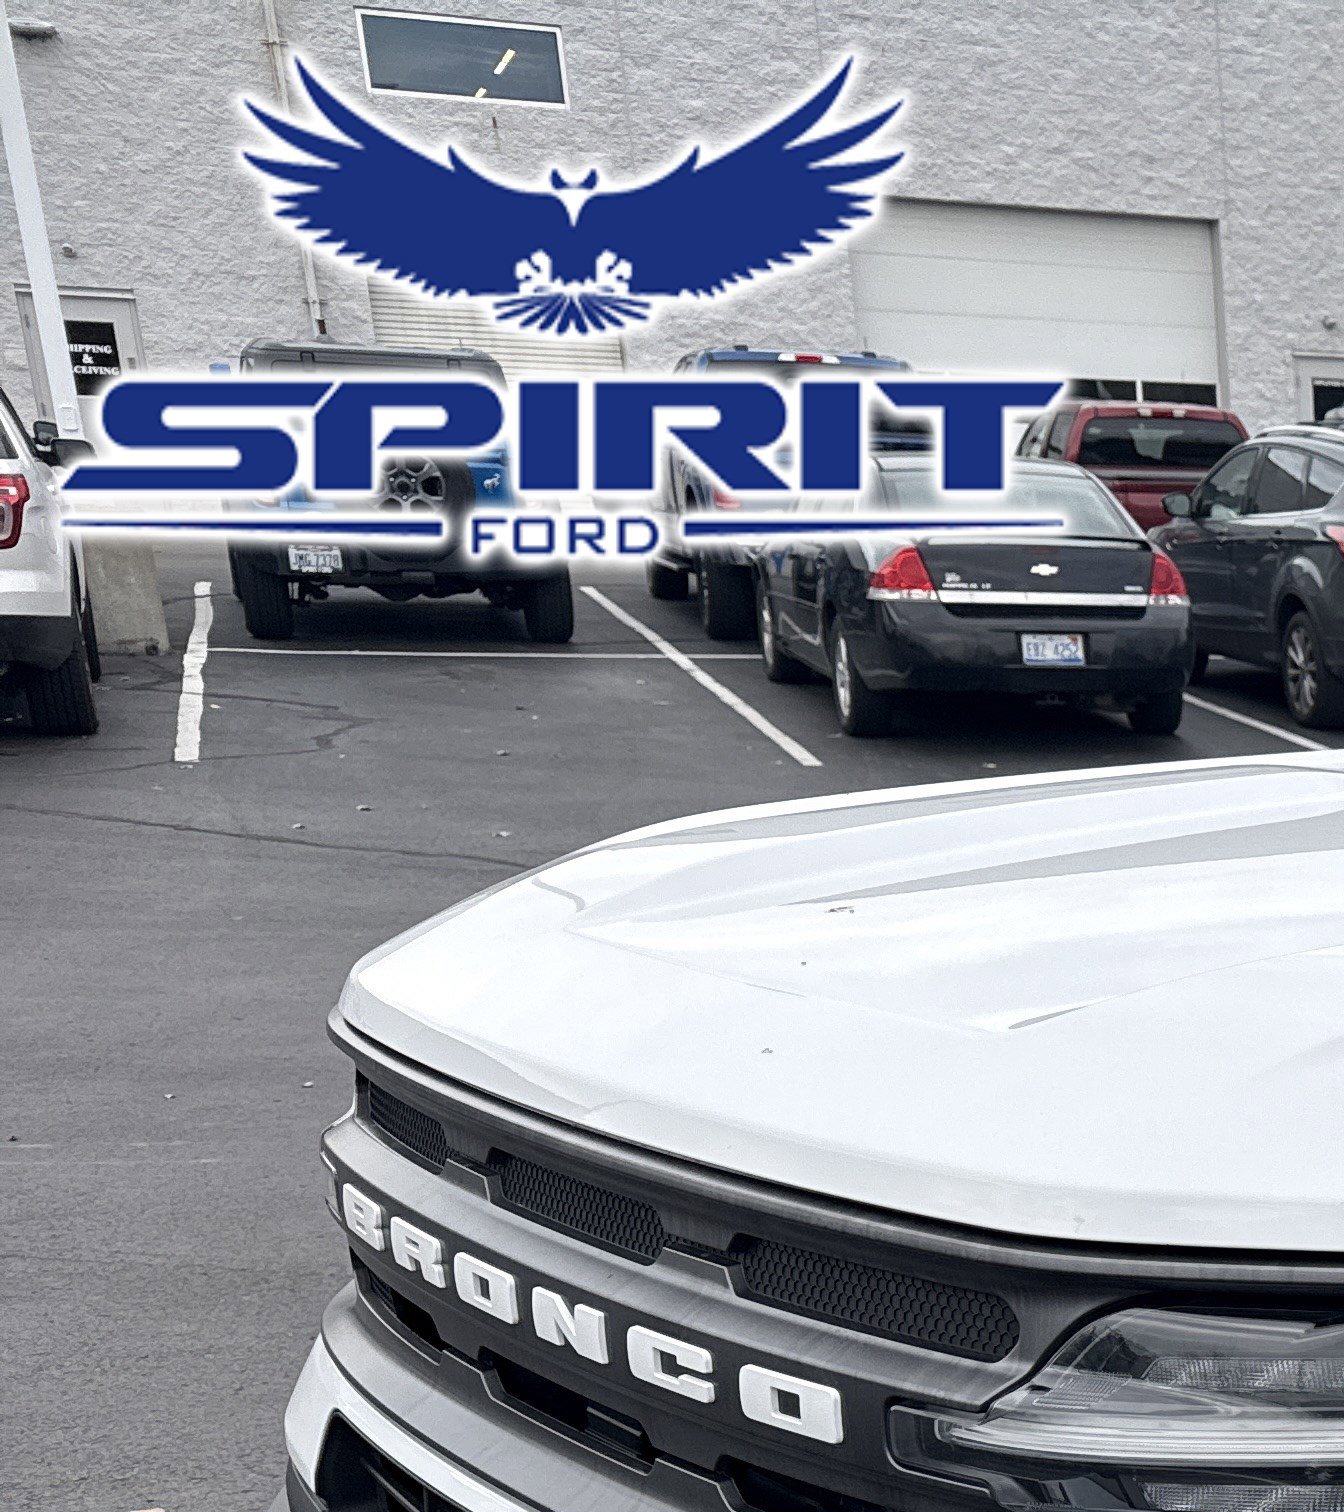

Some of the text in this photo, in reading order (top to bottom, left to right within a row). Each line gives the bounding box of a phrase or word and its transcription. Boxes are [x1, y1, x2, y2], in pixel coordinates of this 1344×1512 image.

[68, 344, 113, 354] IPPING
[82, 353, 94, 364] &
[73, 365, 120, 376] CEIVING
[342, 1182, 844, 1445] BRONCO
